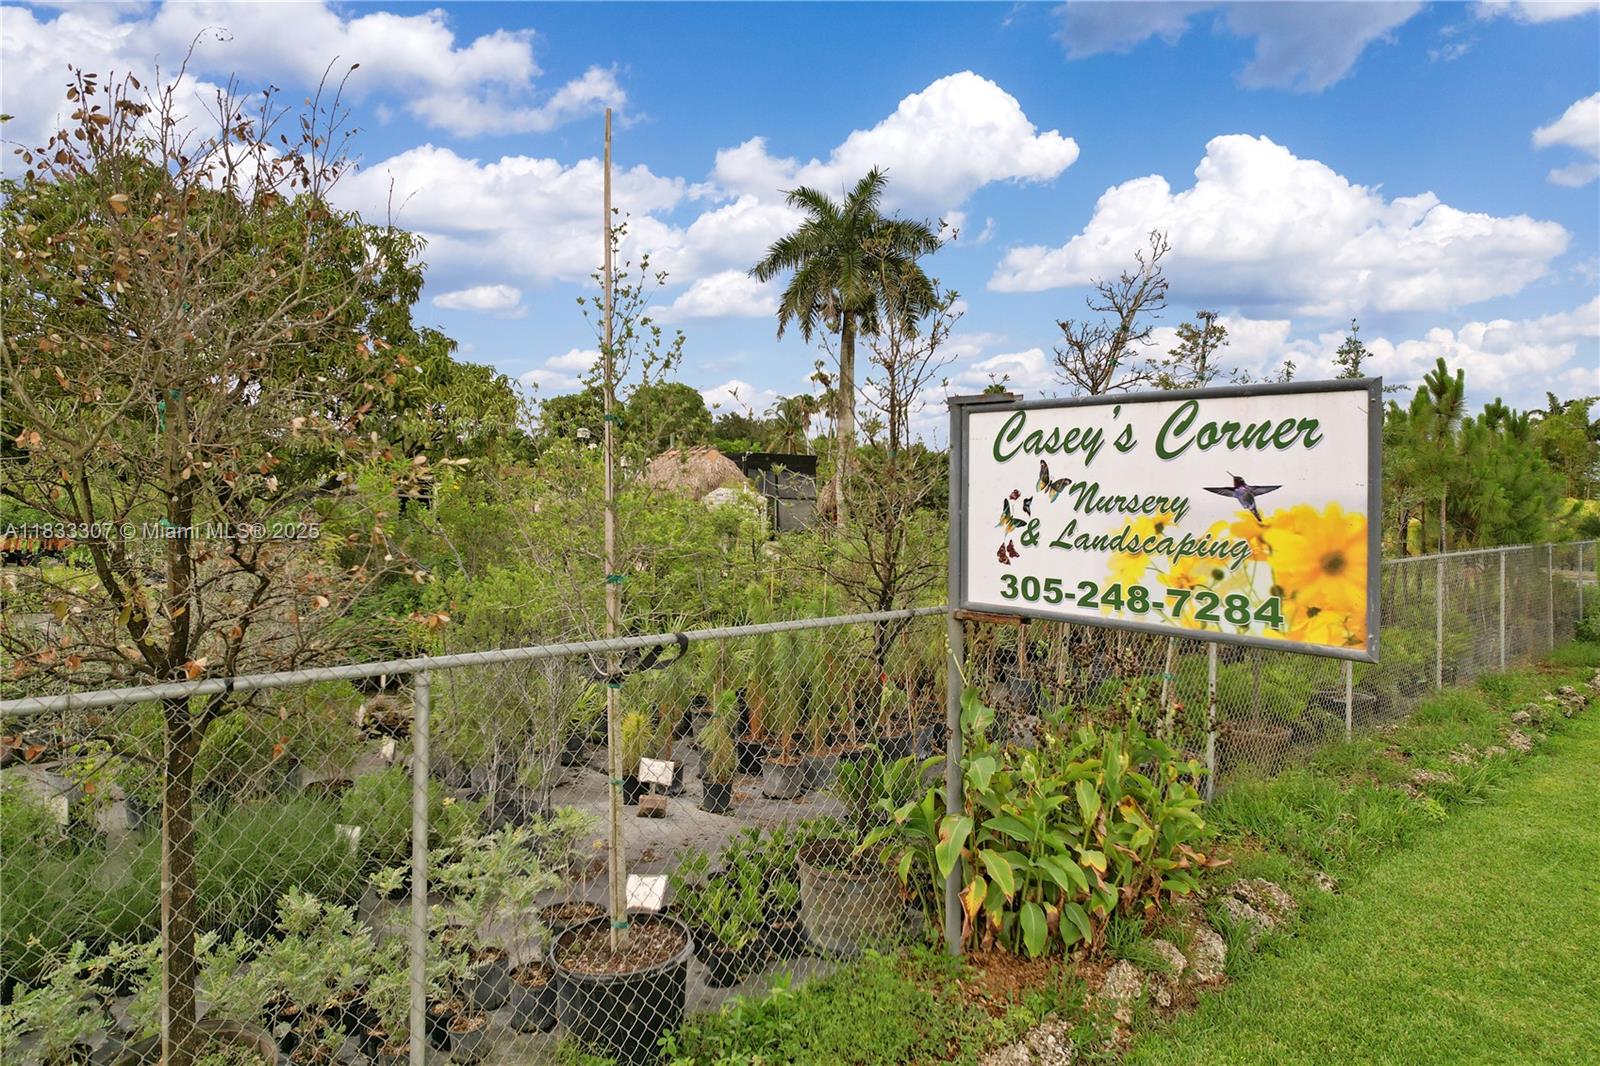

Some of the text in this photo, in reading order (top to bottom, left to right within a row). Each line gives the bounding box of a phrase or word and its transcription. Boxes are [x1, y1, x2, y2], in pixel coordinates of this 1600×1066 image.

[993, 400, 1323, 466] Casey's Corner
[1069, 481, 1189, 521] Nursery
[1020, 518, 1252, 570] & Landscaping
[1000, 573, 1284, 629] 305-248-7284
